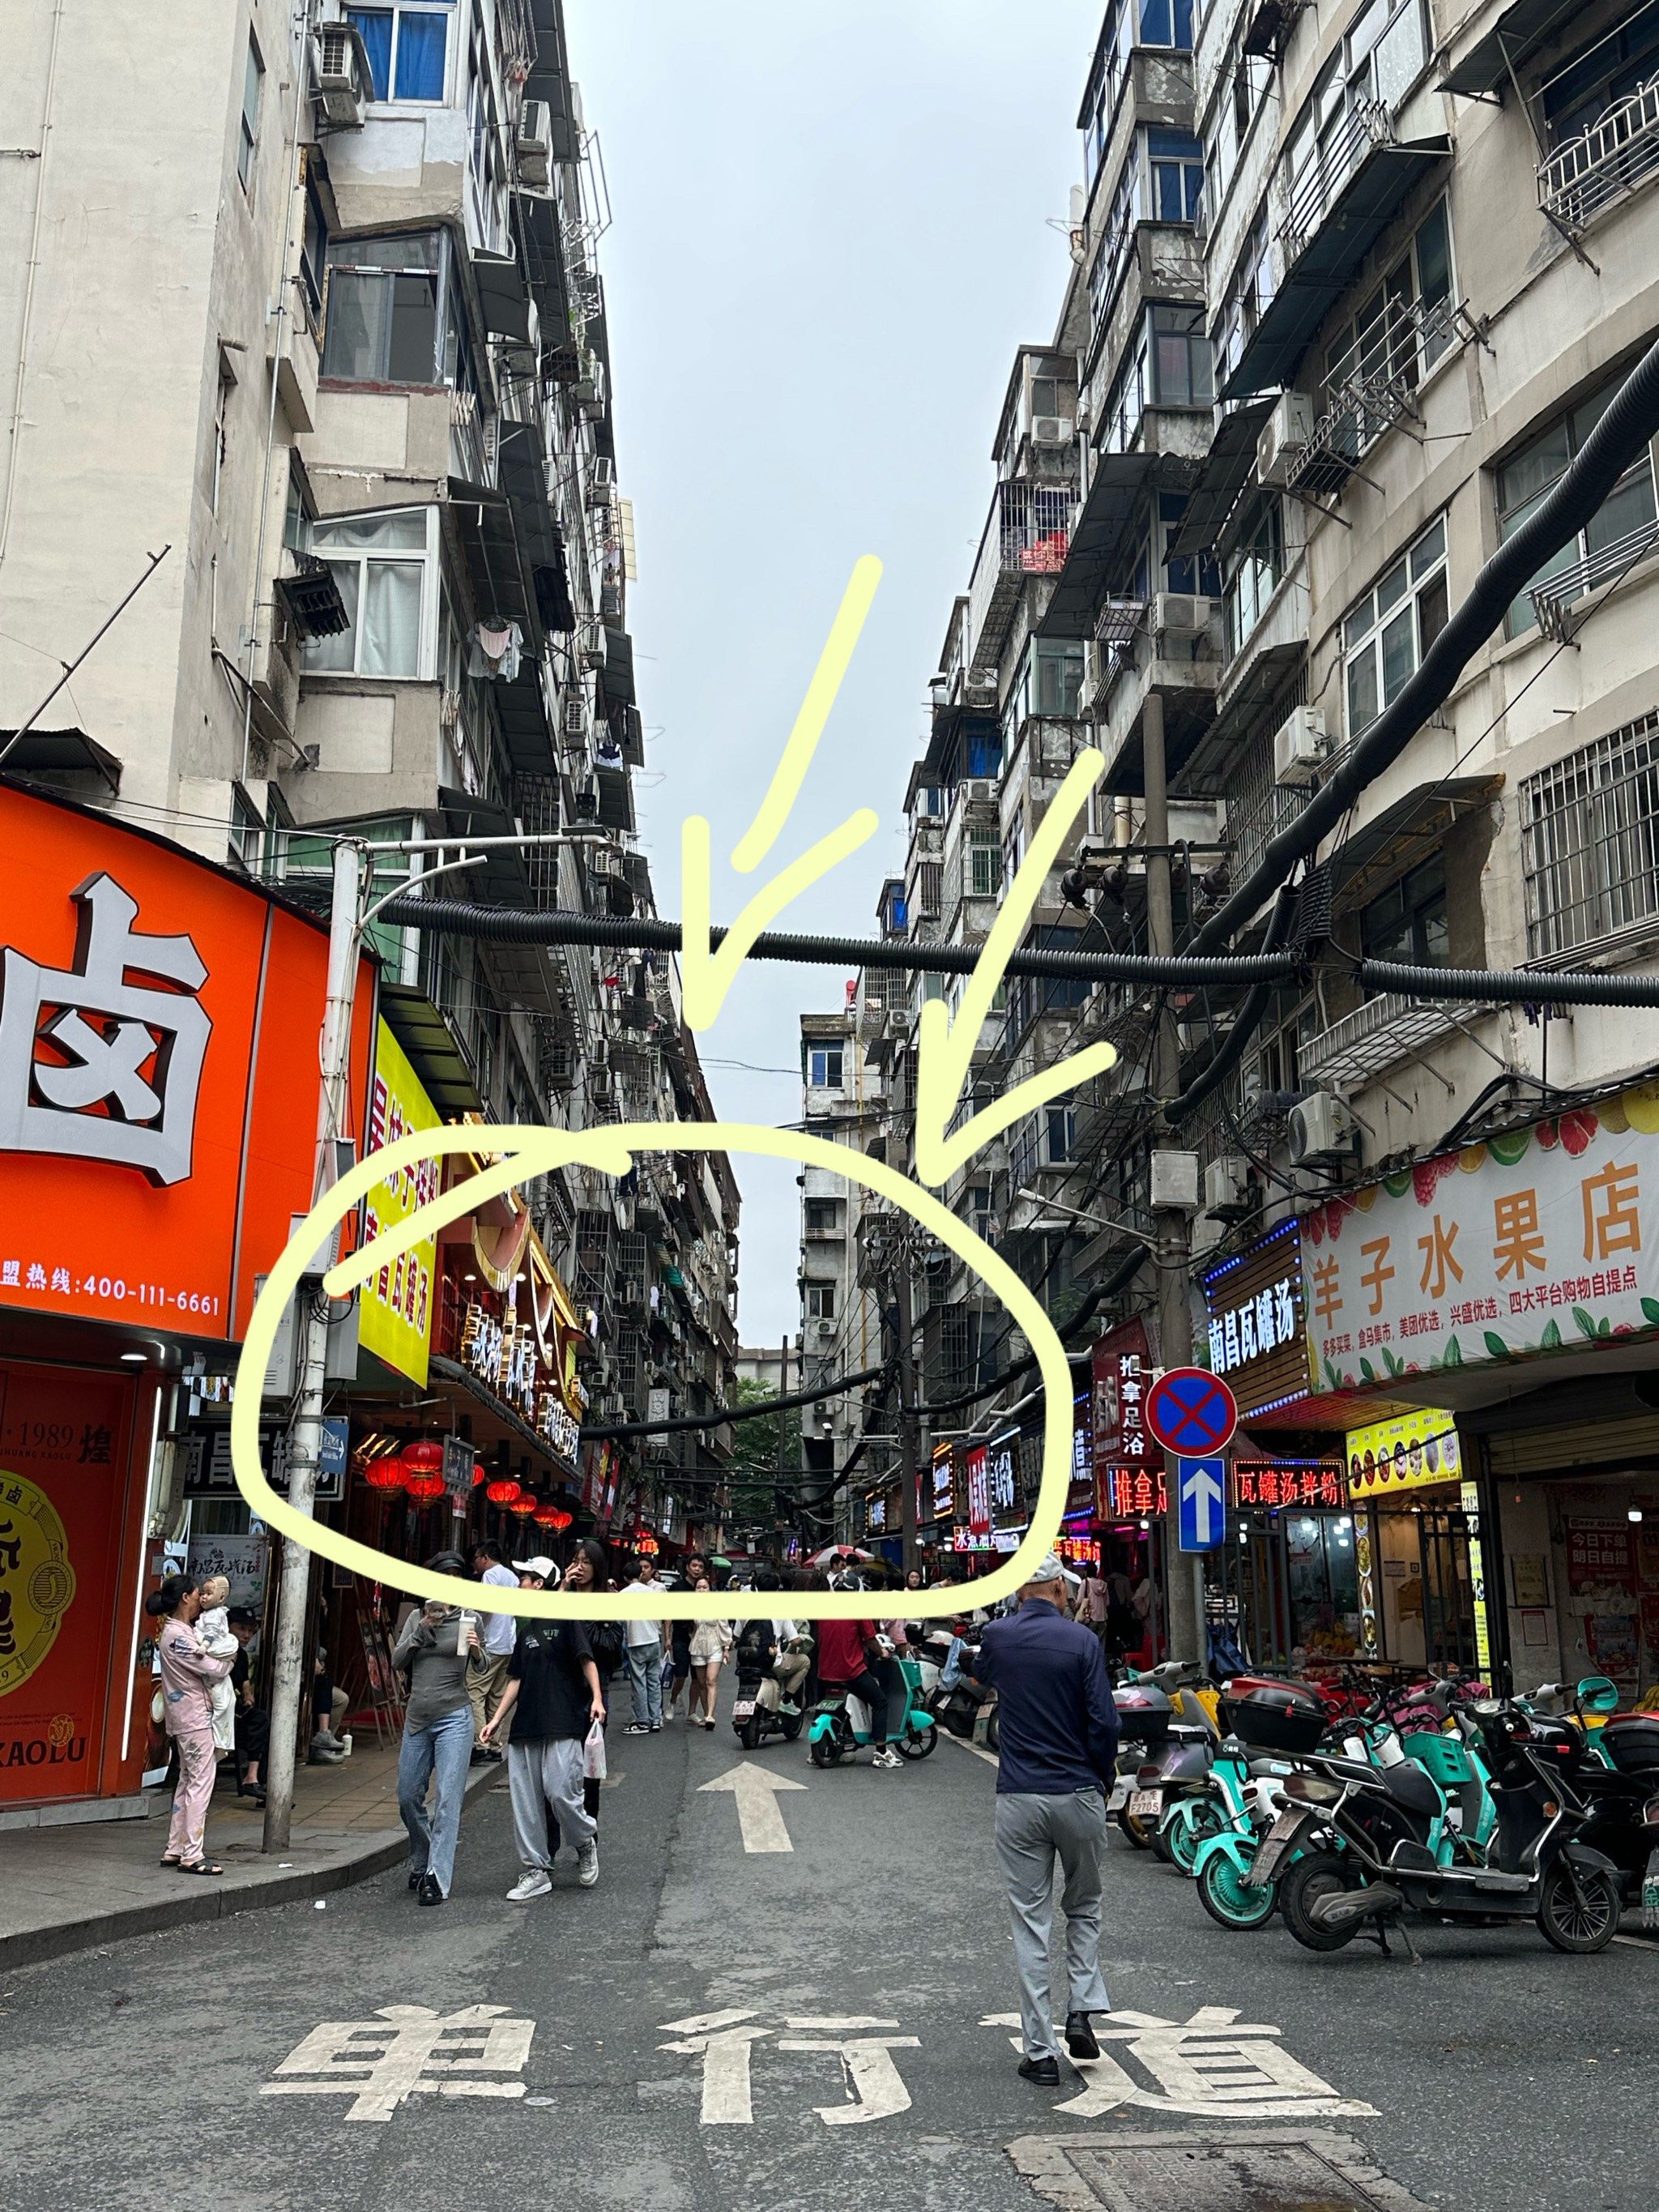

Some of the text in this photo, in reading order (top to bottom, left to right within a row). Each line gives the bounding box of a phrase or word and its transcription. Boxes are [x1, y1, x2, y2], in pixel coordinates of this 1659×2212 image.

[0, 871, 212, 1185] 卤
[1314, 1161, 1642, 1330] 羊子水果店
[1208, 1278, 1294, 1375] 南昌瓦罐汤
[77, 1424, 112, 1464] 煌
[1238, 1471, 1338, 1505] 瓦罐汤拌粉
[1572, 1533, 1627, 1548] 今日下单
[259, 2004, 1382, 2124] 单行道
